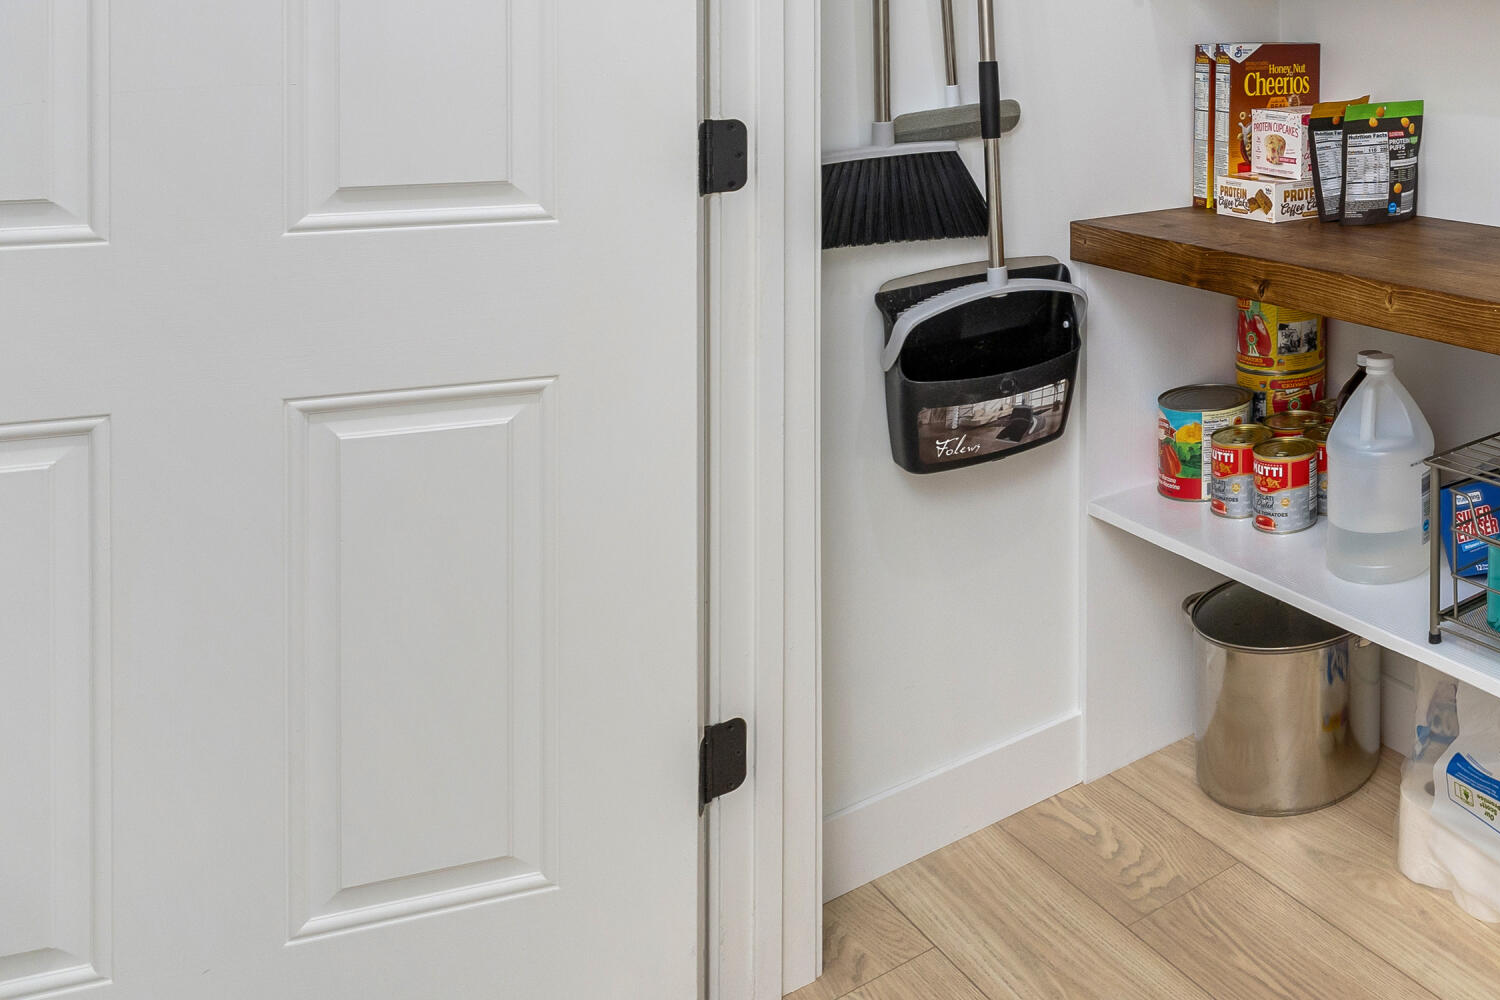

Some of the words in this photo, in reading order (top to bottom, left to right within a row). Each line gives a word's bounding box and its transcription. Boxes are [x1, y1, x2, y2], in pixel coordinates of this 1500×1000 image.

[1268, 64, 1291, 76] Honey
[1293, 63, 1306, 73] Nut
[1244, 71, 1310, 97] Cheerios
[1253, 122, 1273, 132] PROTEIN
[1272, 122, 1299, 138] CUPCAKES
[1220, 185, 1247, 199] PROTEIN
[1280, 201, 1305, 217] Coffee
